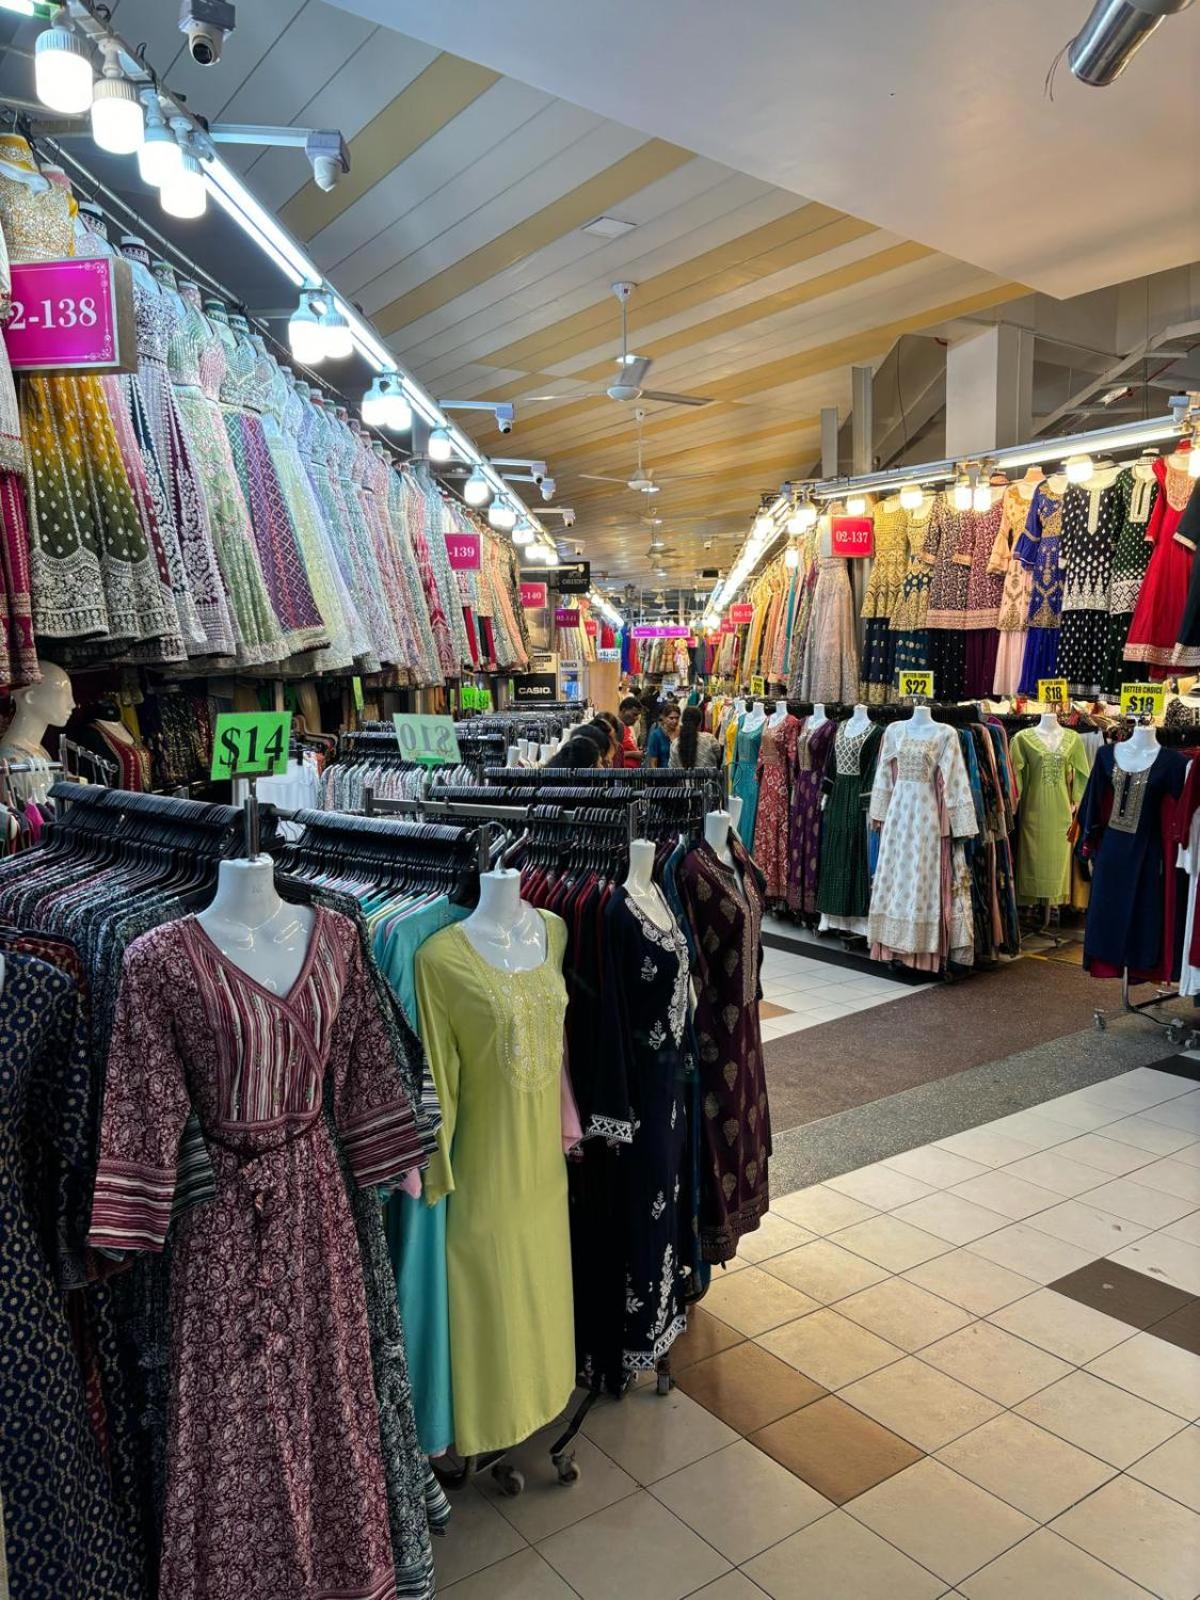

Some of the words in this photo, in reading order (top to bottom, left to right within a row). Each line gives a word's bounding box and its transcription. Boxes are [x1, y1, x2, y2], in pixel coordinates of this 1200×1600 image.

[835, 530, 869, 544] 02-137
[518, 686, 551, 694] CASIO
[905, 679, 927, 695] $22
[1045, 686, 1062, 701] $18
[1123, 685, 1142, 694] BETTER
[1143, 686, 1163, 695] CHOICE
[1129, 696, 1154, 712] $18
[219, 723, 284, 768] $14
